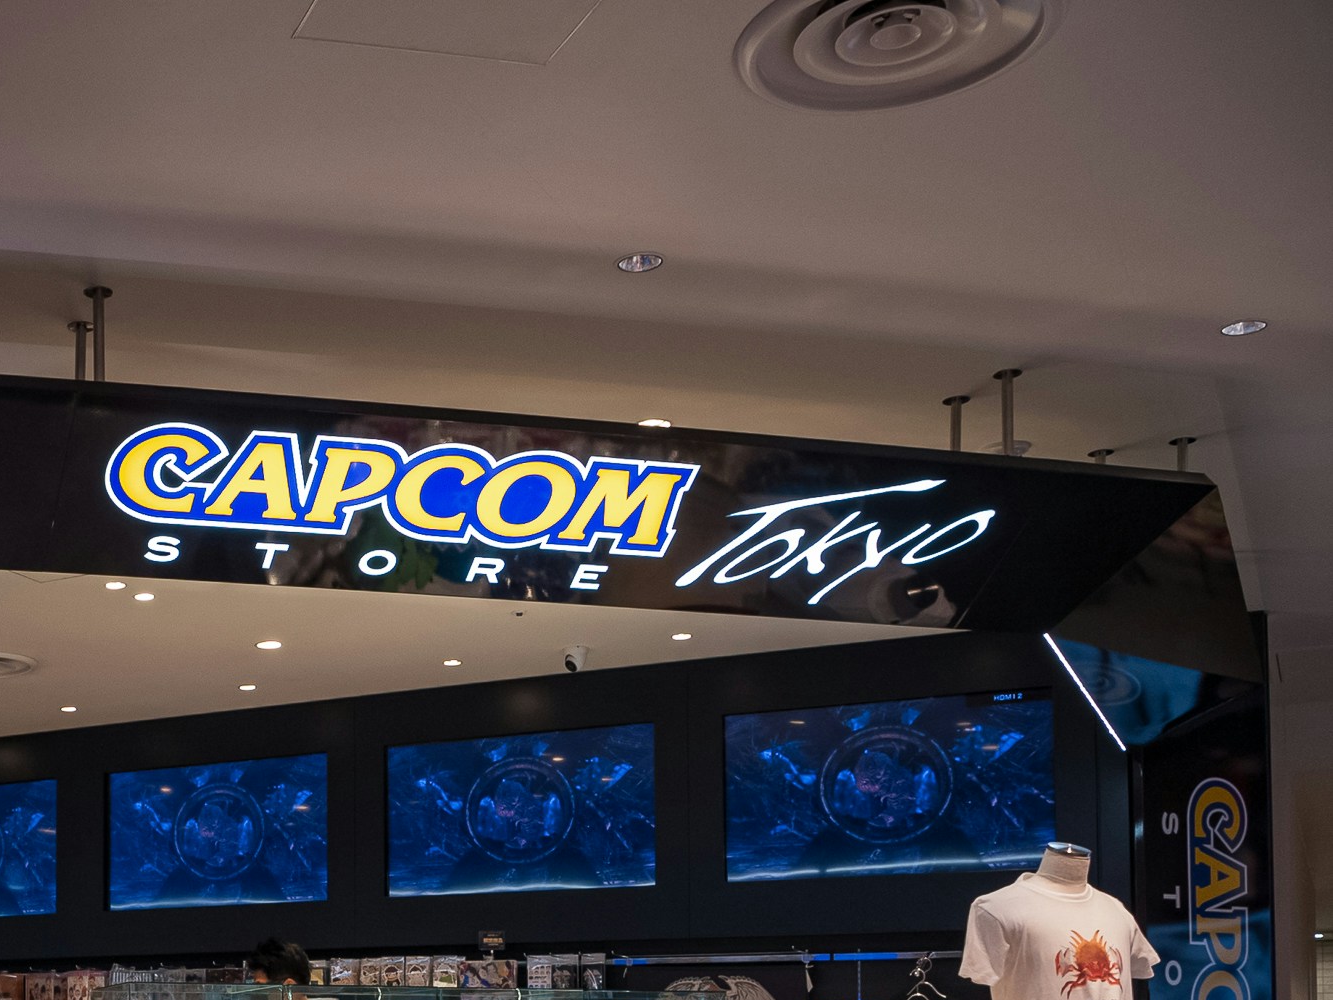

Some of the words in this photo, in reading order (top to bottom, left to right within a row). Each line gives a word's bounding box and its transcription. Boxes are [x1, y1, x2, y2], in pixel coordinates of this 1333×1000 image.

[104, 421, 700, 558] CAPCOM
[675, 479, 996, 605] Tokyo
[144, 536, 609, 592] STORE
